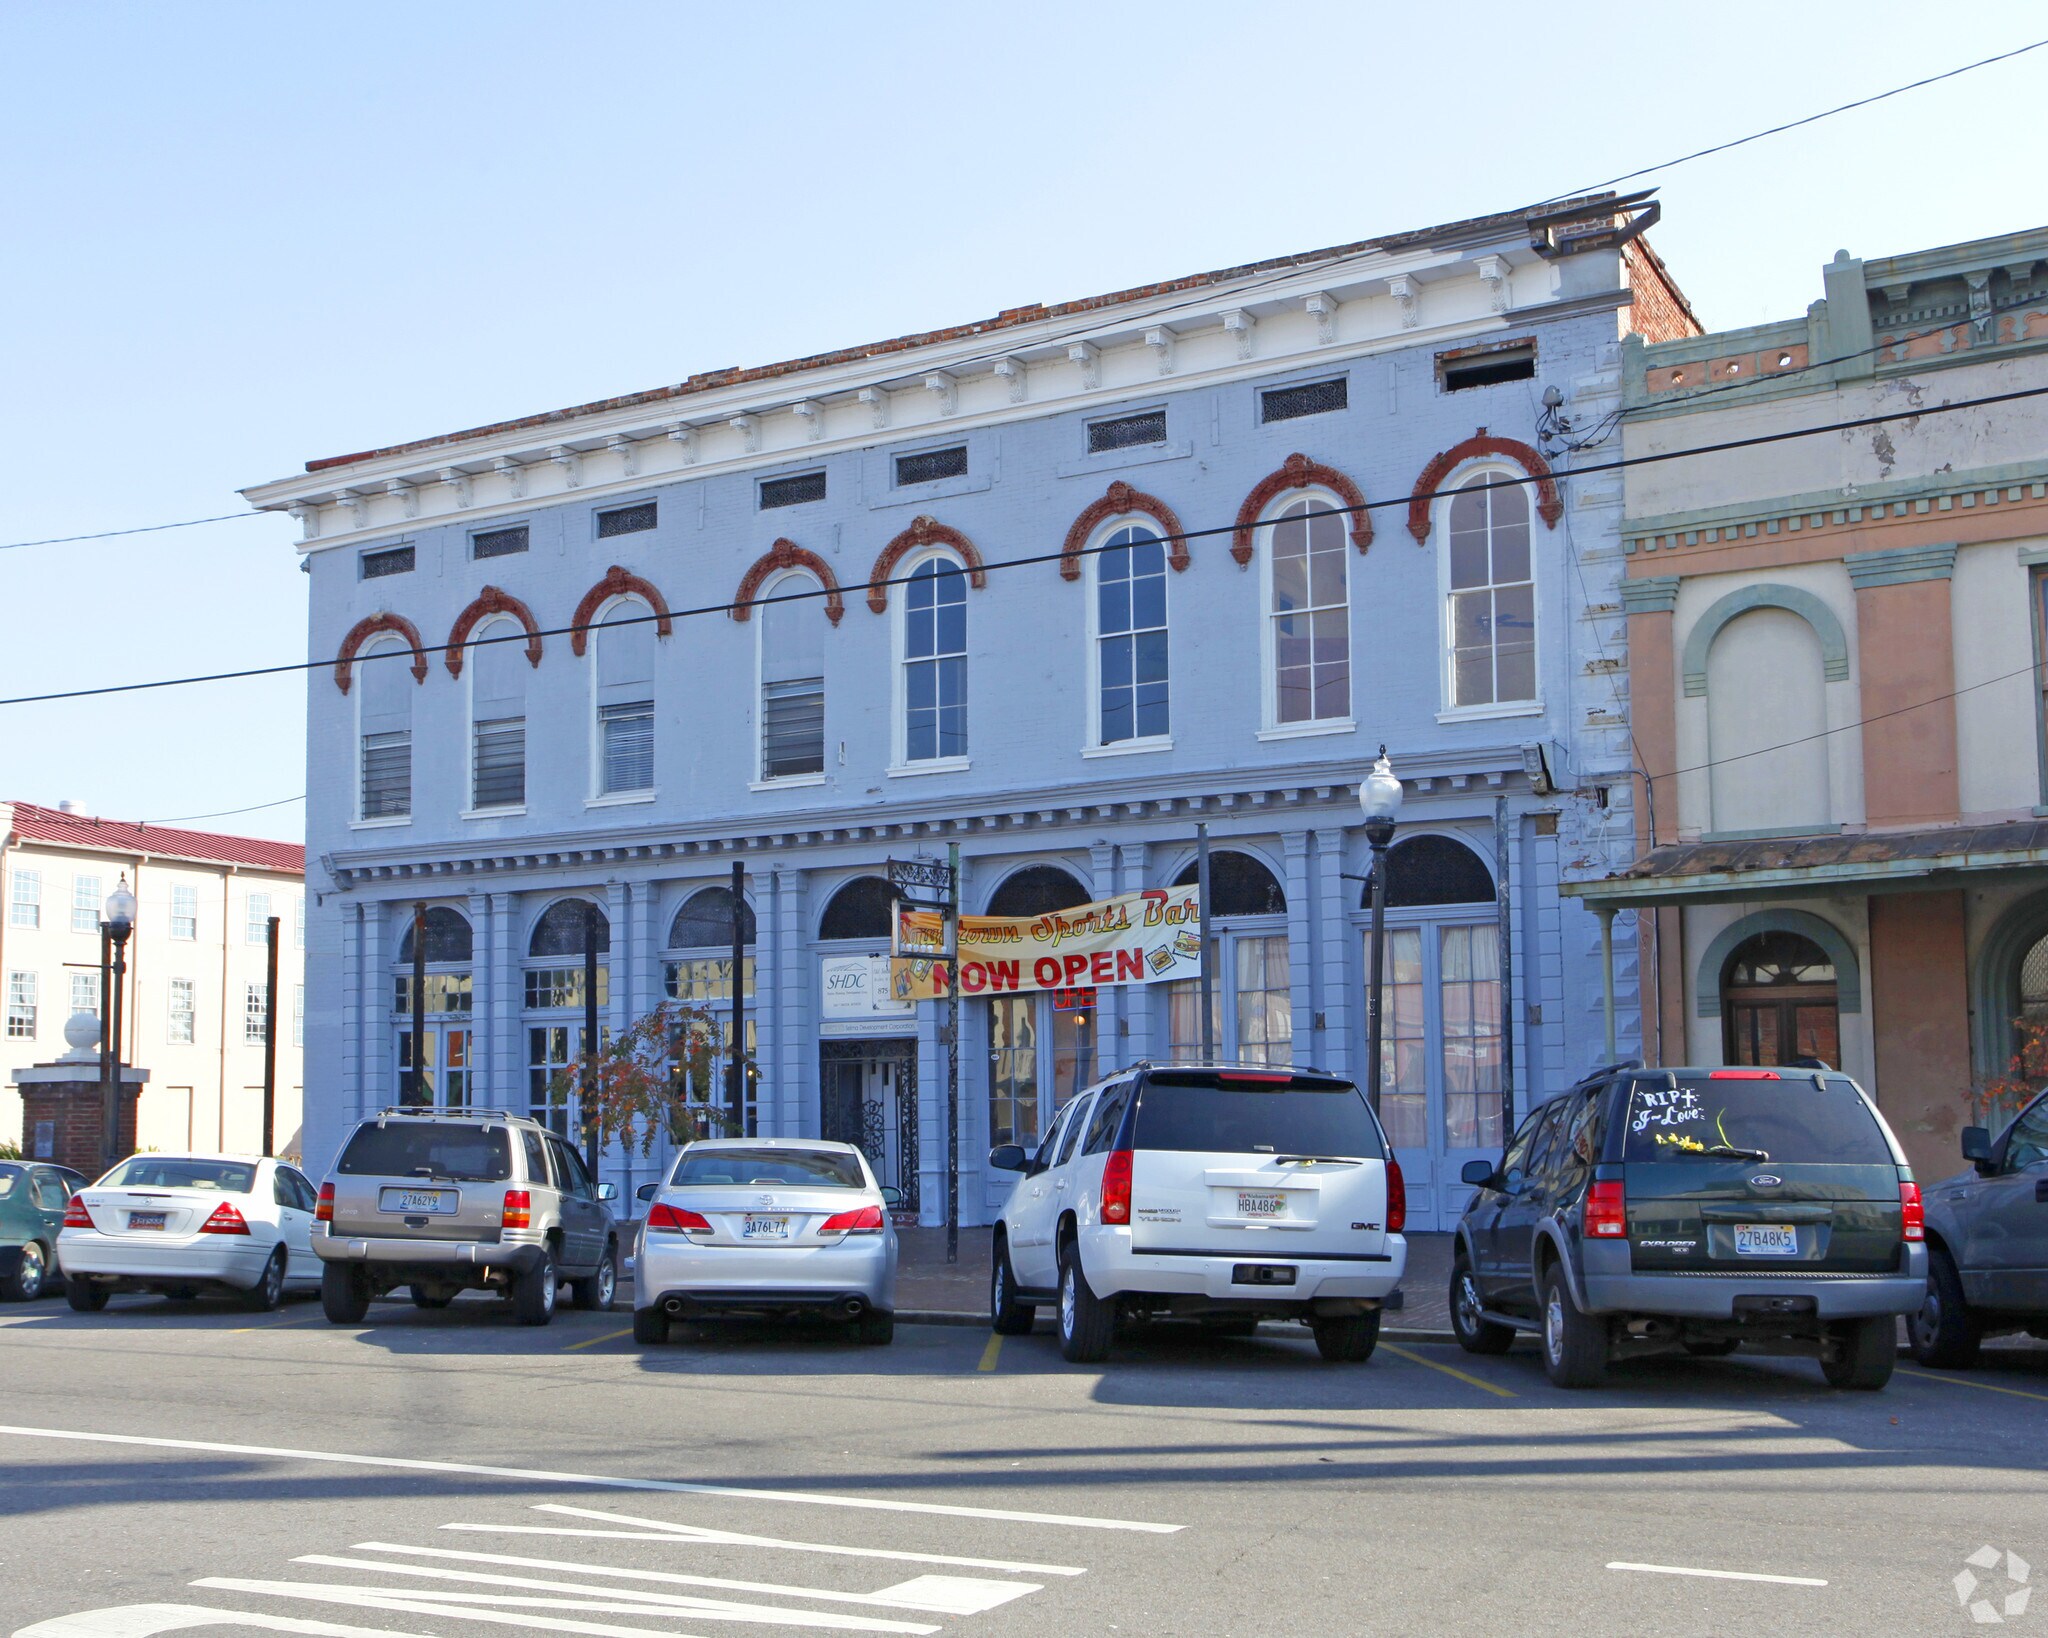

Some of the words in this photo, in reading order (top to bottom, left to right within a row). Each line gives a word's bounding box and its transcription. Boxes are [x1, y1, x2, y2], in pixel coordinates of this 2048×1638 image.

[1031, 904, 1132, 948] Sports
[1140, 889, 1200, 927] Bar
[934, 960, 1020, 995] NOW
[1034, 947, 1144, 989] OPEN
[827, 973, 868, 990] SHDC
[1053, 986, 1098, 1009] OPE
[1643, 1090, 1680, 1107] RIP
[401, 1194, 439, 1207] 27A62Y9
[1238, 1199, 1276, 1213] HBA486
[745, 1221, 787, 1233] 3A76L77
[1351, 1222, 1380, 1231] GMC
[1739, 1231, 1792, 1247] 27B48K5
